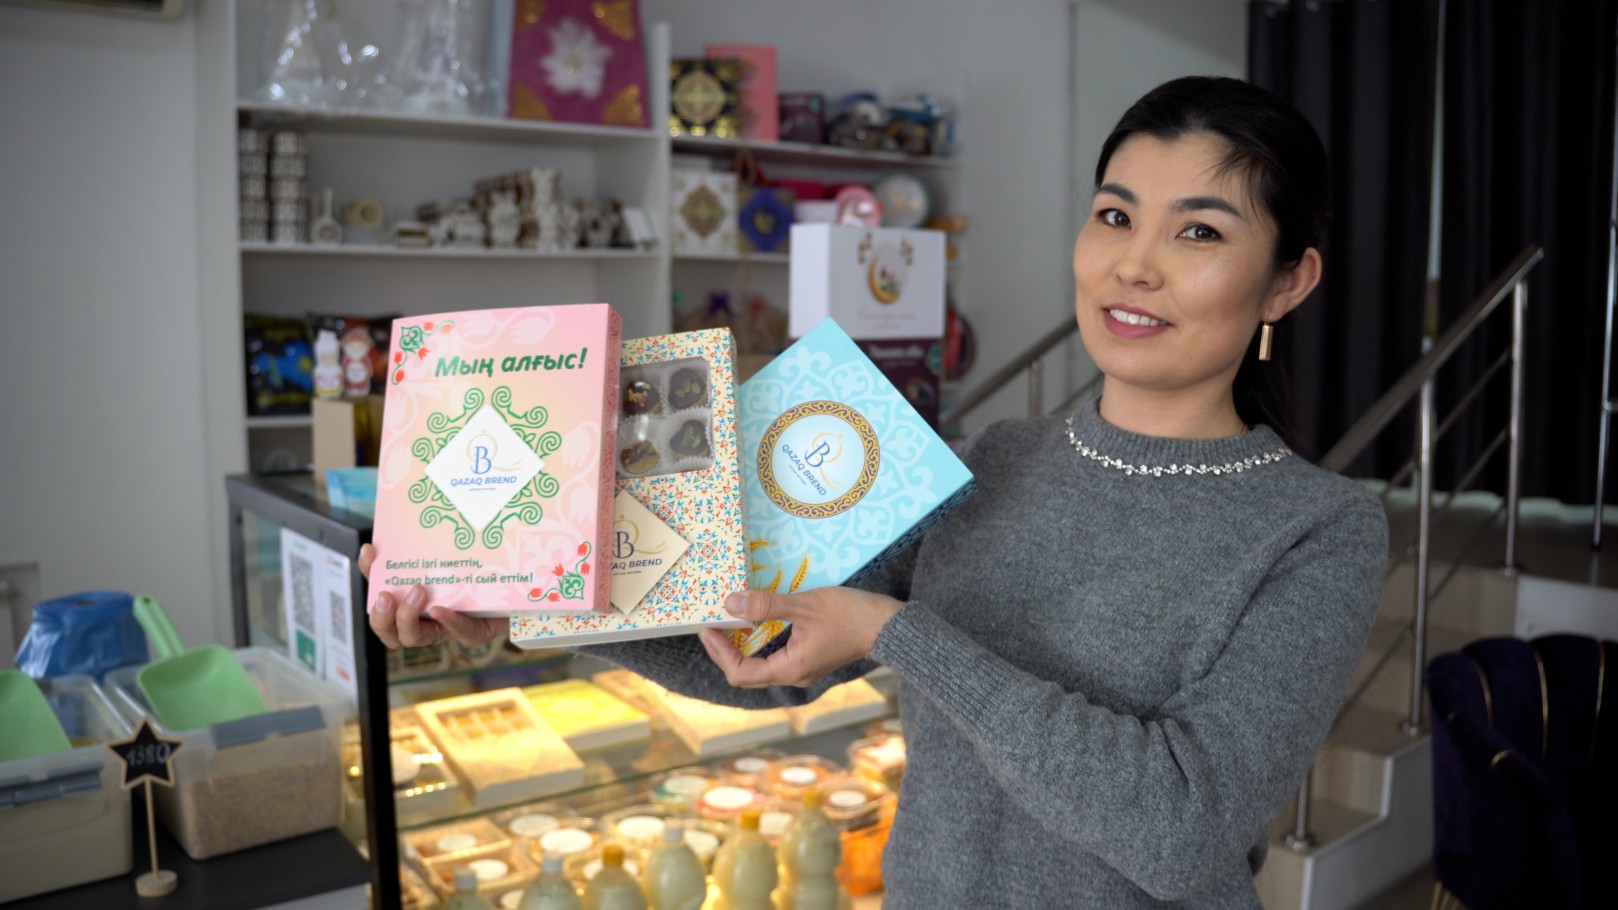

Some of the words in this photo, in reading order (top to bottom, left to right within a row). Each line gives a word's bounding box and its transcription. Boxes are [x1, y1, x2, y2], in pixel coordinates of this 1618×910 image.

[435, 356, 494, 377] Мың
[501, 347, 588, 373] алғыс!
[782, 444, 806, 471] QAZAQ
[803, 470, 827, 496] BREND
[450, 478, 483, 487] QAZAQ
[484, 476, 518, 485] BREND
[385, 560, 419, 570] Белгісі
[628, 558, 663, 568] BREND
[476, 573, 497, 583] сый
[500, 572, 533, 583] еттім!
